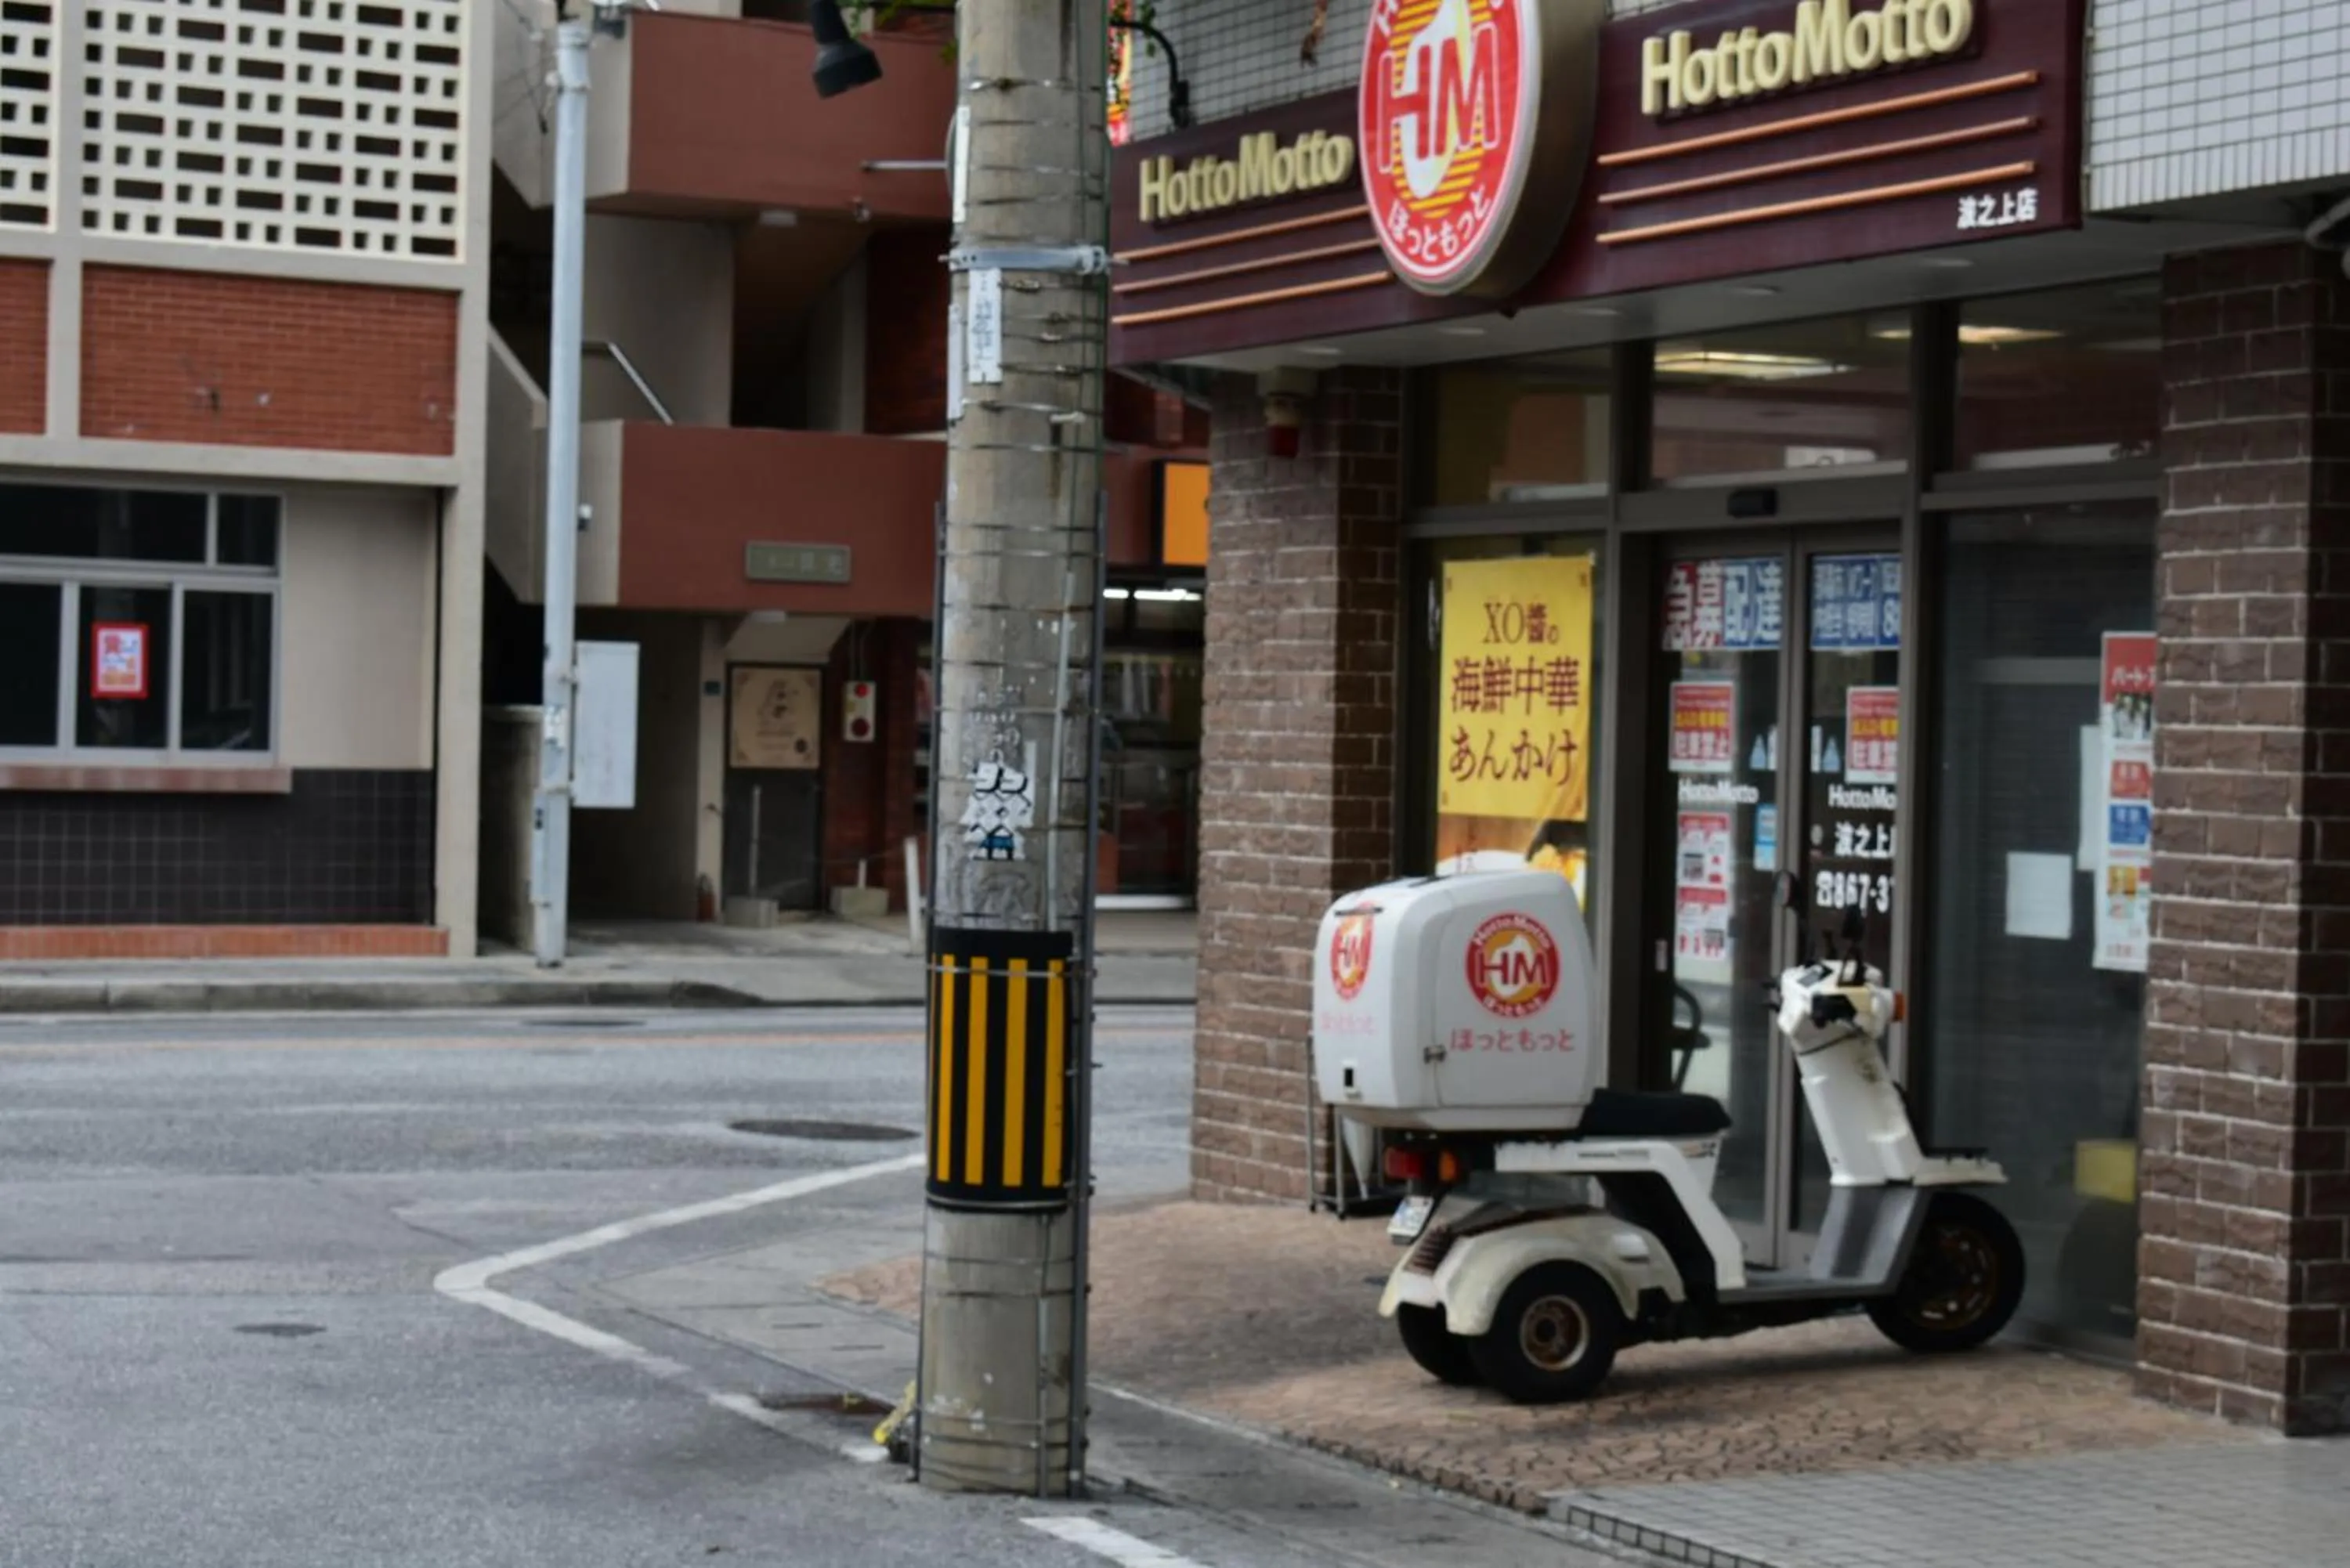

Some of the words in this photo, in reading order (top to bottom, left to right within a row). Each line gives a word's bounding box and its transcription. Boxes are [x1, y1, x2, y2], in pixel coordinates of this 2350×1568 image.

[1642, 0, 1972, 114] HottoMotto
[1140, 130, 1354, 222] HottoMotto
[1387, 183, 1491, 261] ほっともっと
[1958, 188, 2037, 229] 波之上店
[1451, 656, 1580, 716] 海鮮中華
[1449, 724, 1578, 786] あんかけ
[1477, 948, 1550, 987] HM
[1450, 1027, 1575, 1053] ほっともっと
